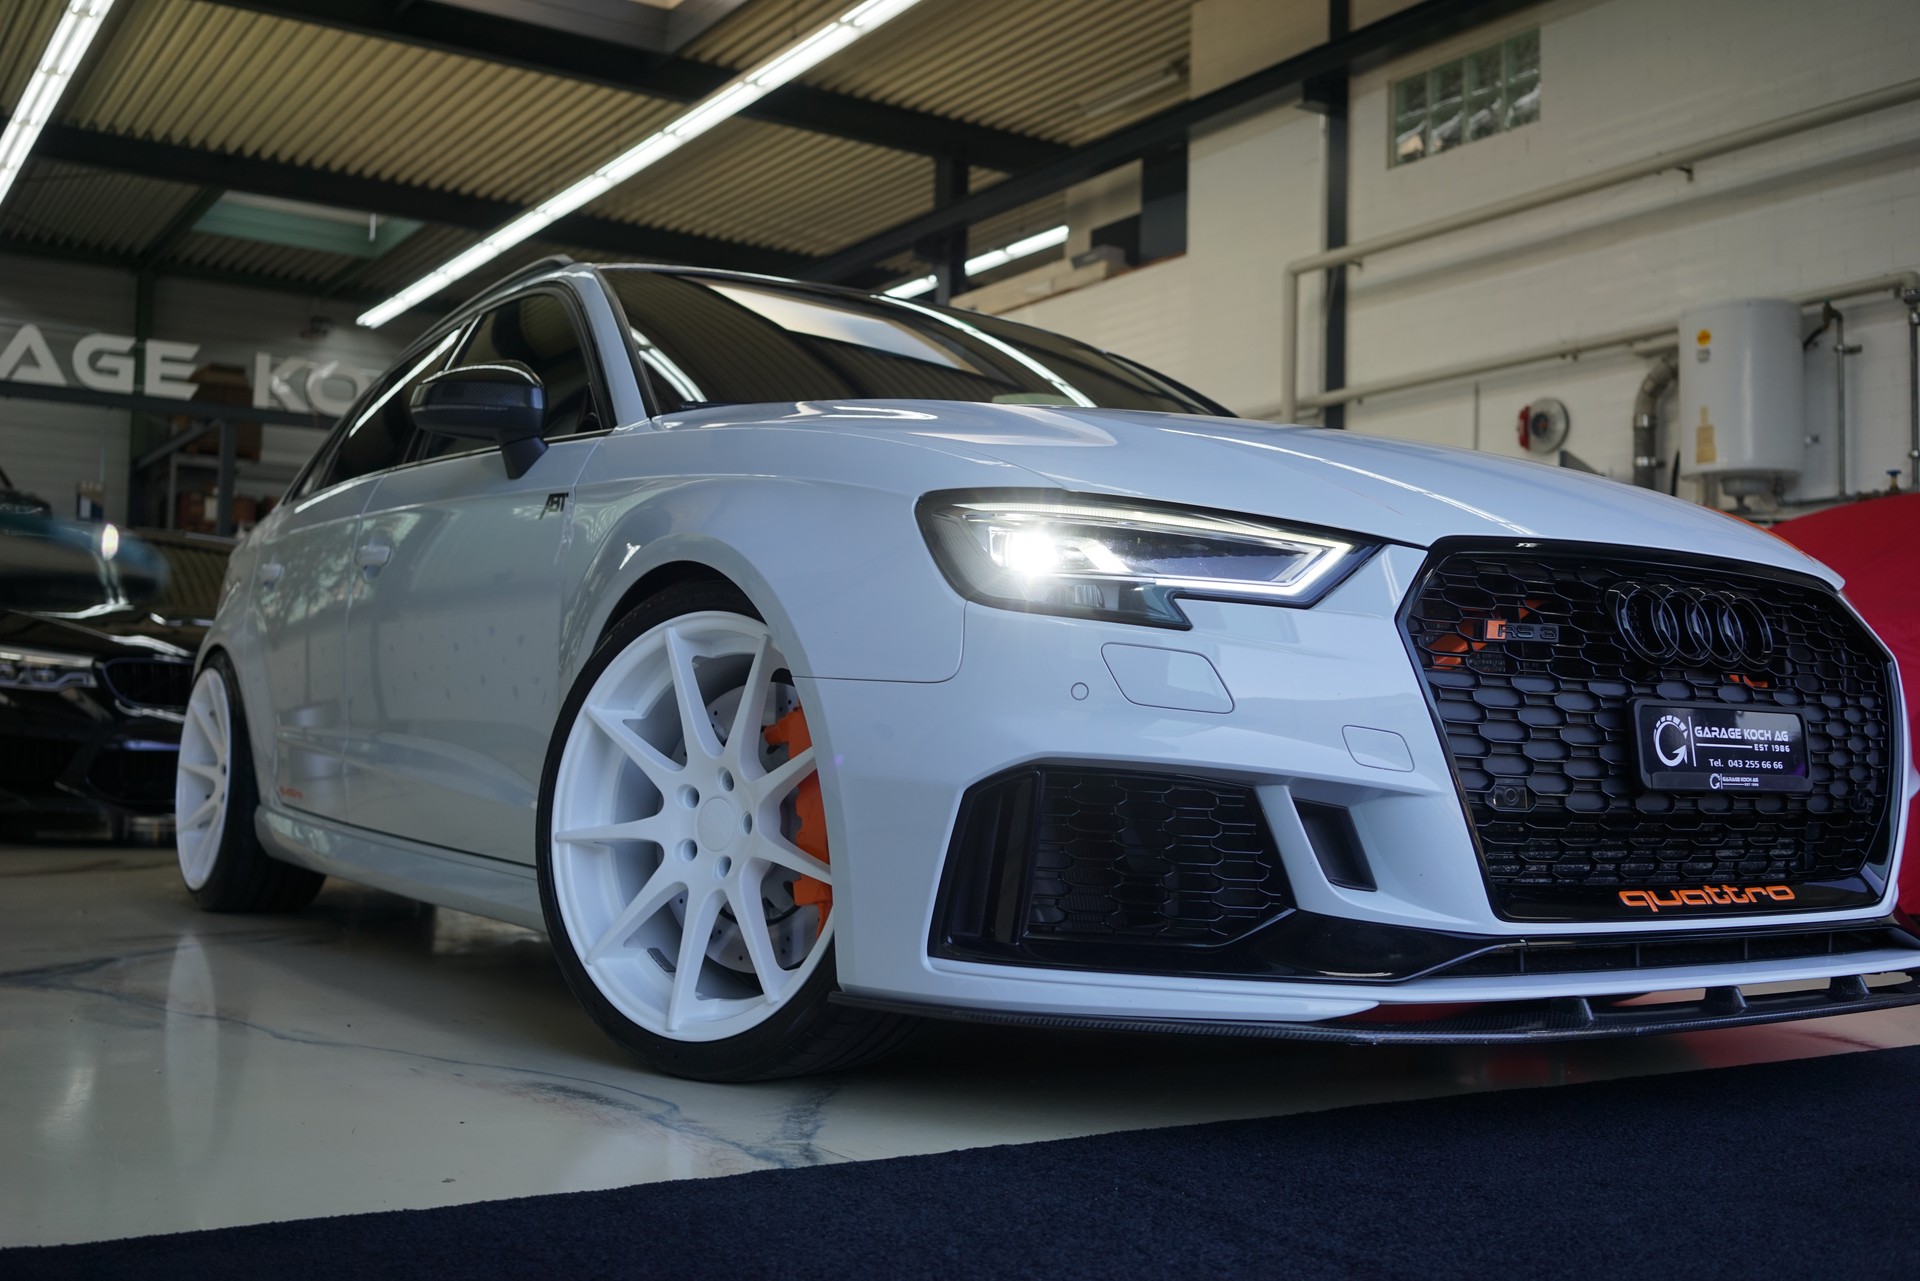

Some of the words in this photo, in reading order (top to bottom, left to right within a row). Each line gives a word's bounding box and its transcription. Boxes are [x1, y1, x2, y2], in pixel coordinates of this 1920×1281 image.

[539, 492, 569, 520] ABT
[1497, 623, 1535, 638] RS
[1540, 625, 1557, 640] 3
[1694, 726, 1742, 739] GARAGE
[1743, 728, 1772, 741] KOCH
[1774, 730, 1789, 742] AG
[1753, 744, 1769, 752] EST
[1771, 744, 1790, 753] 1986
[1708, 758, 1724, 767] Tel.
[1728, 759, 1743, 768] 043
[1745, 760, 1760, 769] 255
[1761, 760, 1772, 769] 66
[1773, 761, 1783, 770] 66
[1618, 884, 1796, 912] quattro
